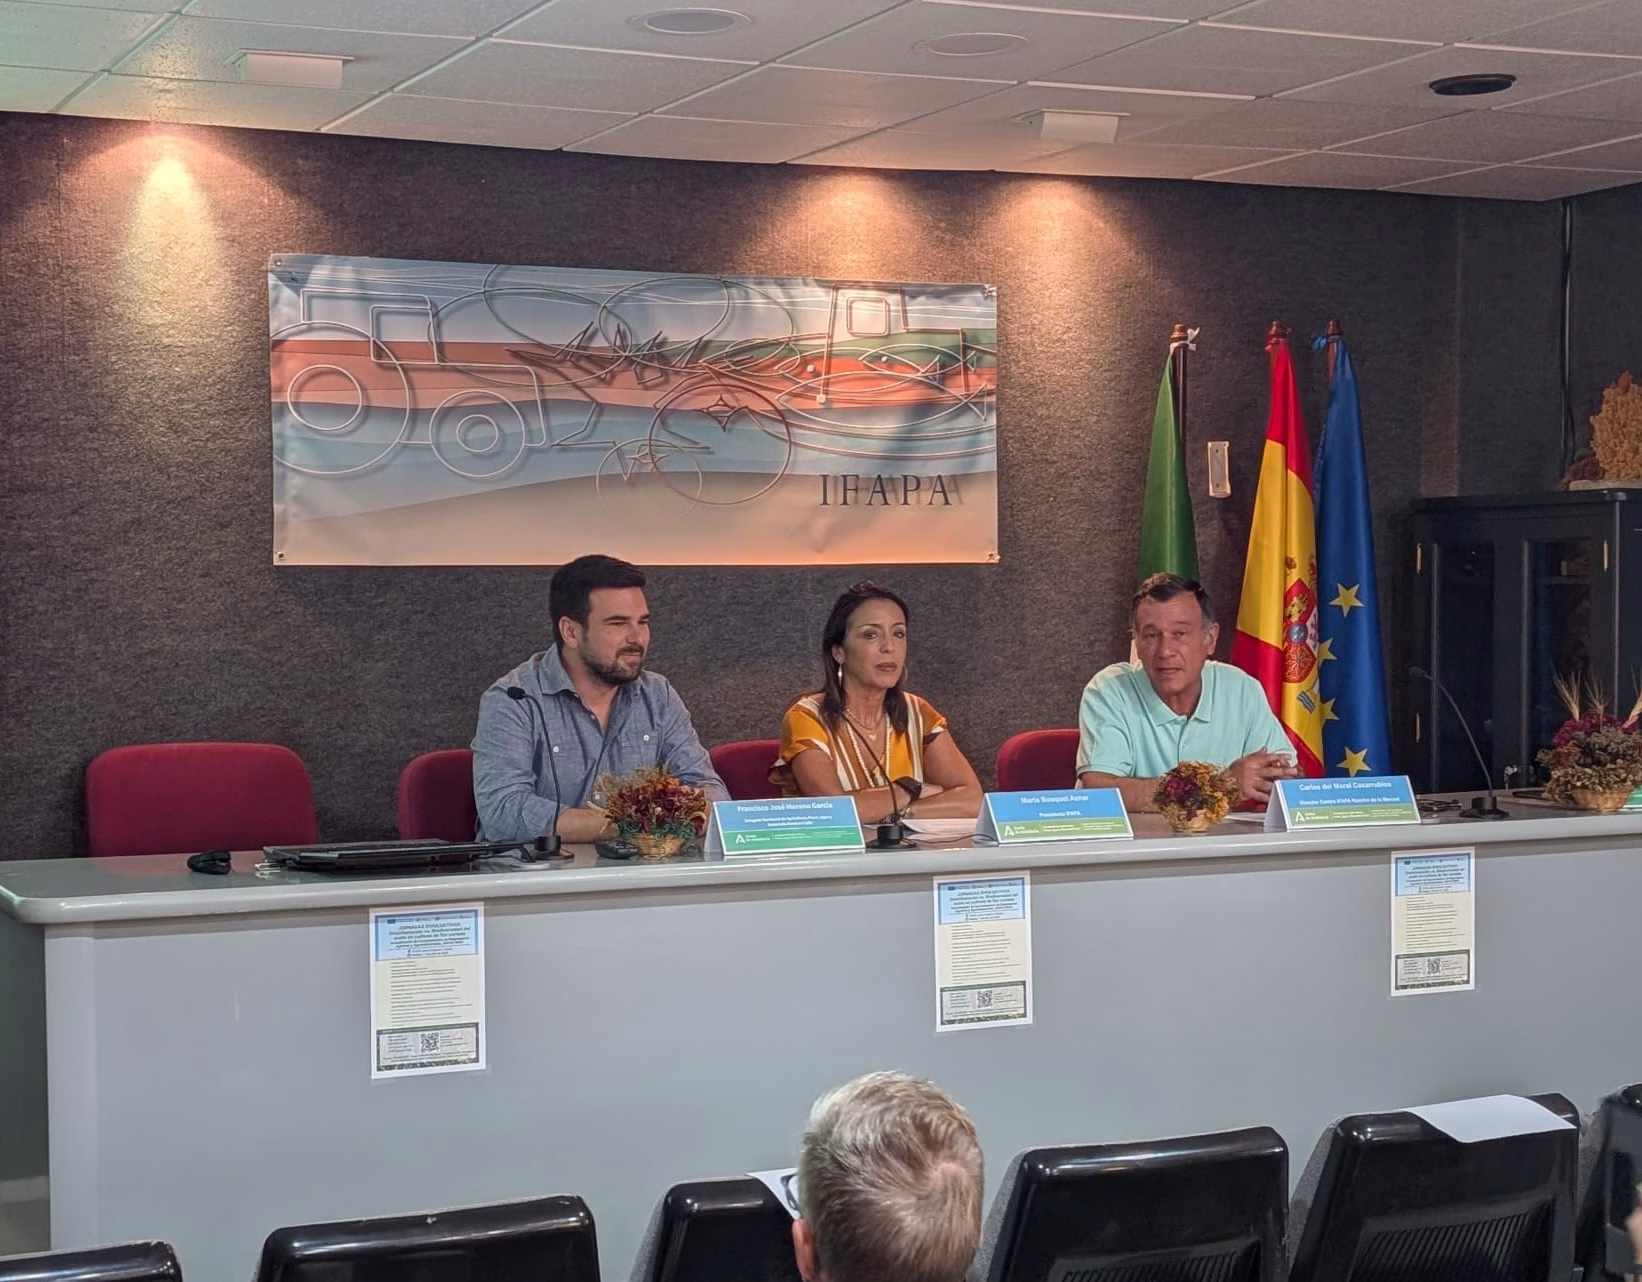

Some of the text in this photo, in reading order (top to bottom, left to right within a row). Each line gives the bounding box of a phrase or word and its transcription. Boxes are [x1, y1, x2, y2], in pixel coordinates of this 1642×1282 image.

[819, 474, 953, 506] IFAPA
[1299, 783, 1321, 791] Carlos
[737, 801, 833, 812] Francisco José Moreno García
